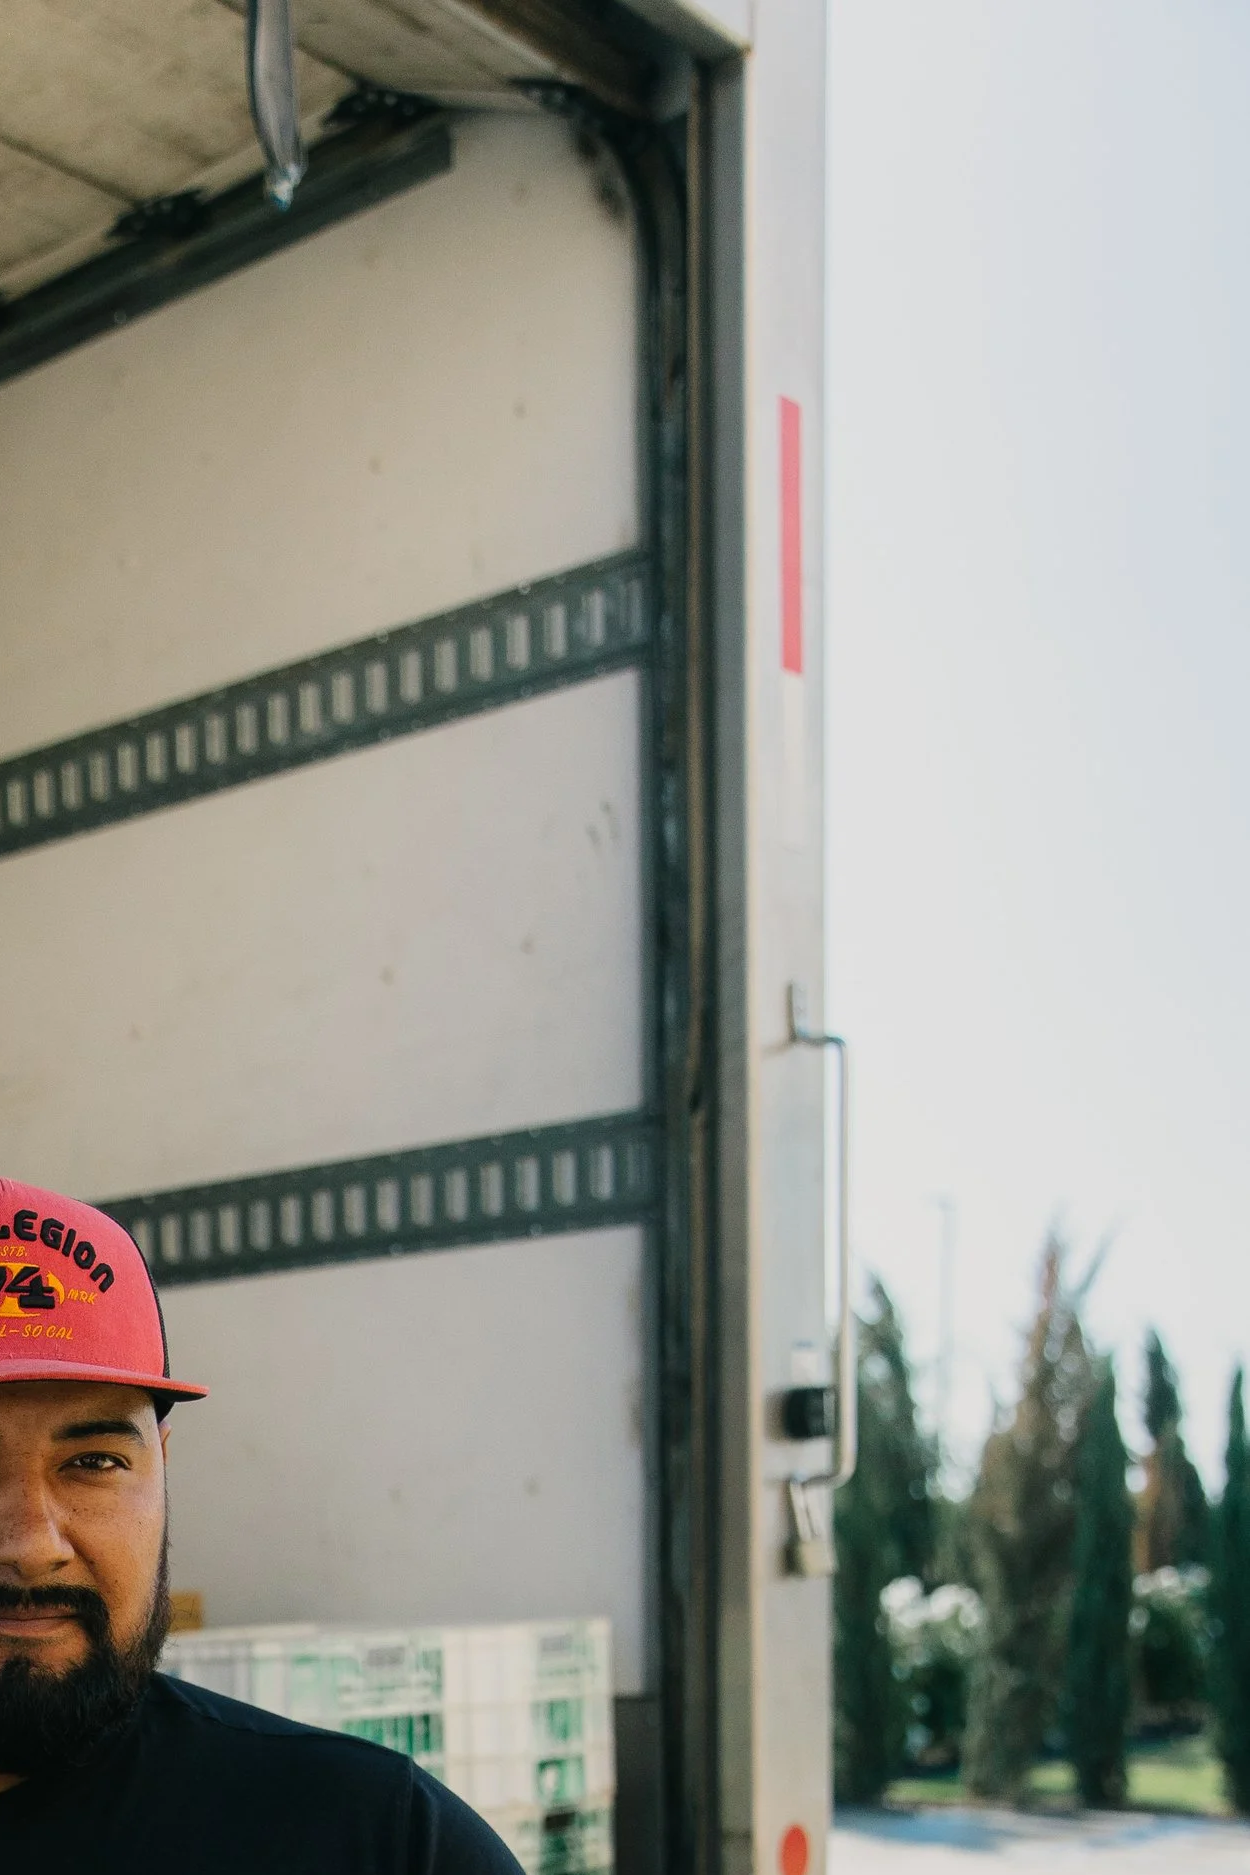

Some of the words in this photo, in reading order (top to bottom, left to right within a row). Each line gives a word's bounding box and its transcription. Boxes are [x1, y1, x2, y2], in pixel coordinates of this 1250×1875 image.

[67, 1288, 98, 1305] MRK
[21, 1324, 44, 1338] SO
[45, 1325, 74, 1341] CAL
